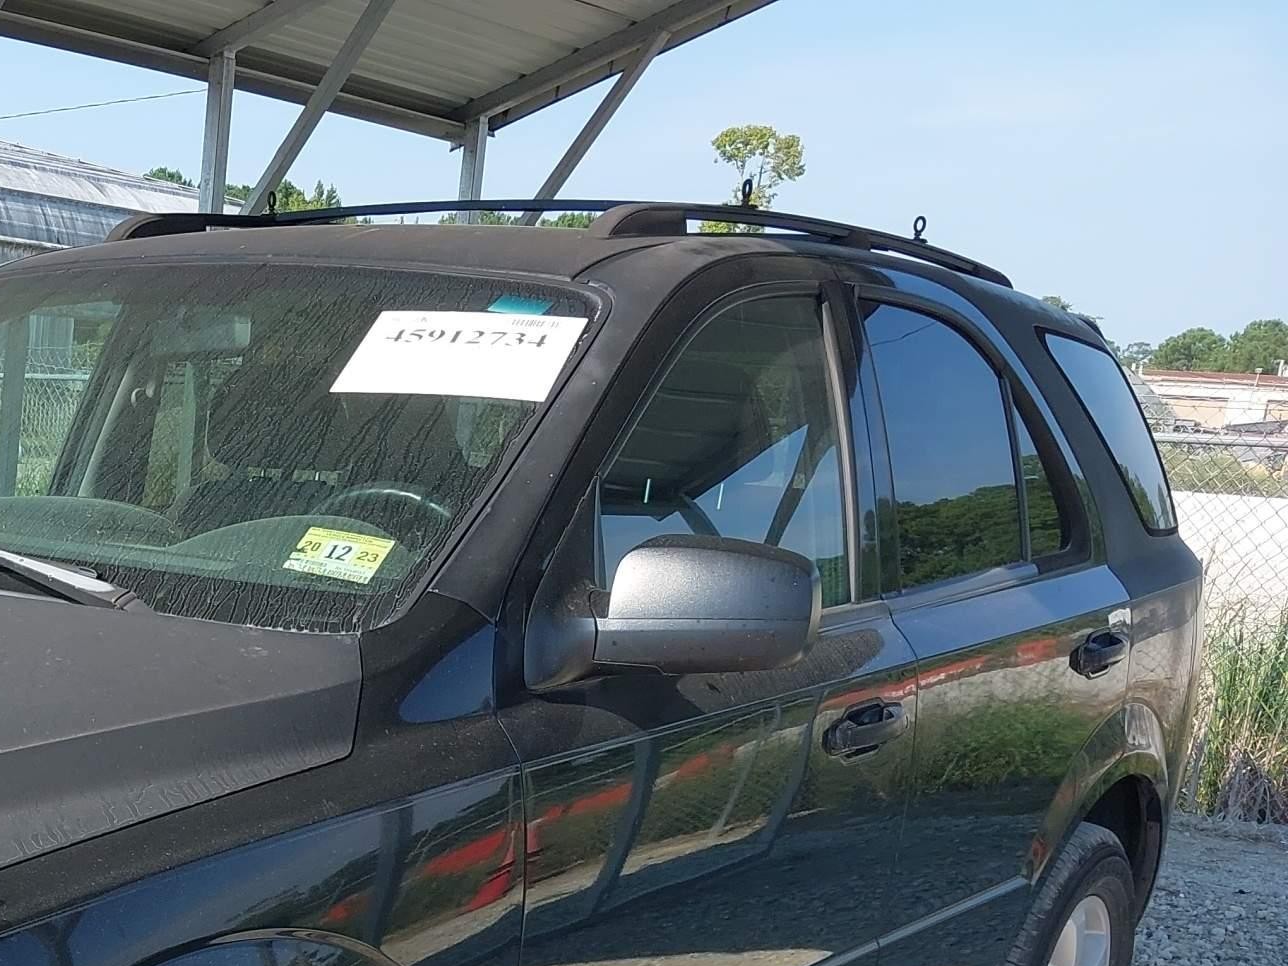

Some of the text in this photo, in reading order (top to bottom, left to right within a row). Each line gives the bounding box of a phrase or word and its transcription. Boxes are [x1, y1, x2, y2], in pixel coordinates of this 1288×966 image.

[385, 328, 548, 348] 45912734
[303, 540, 380, 563] 20 12 23
